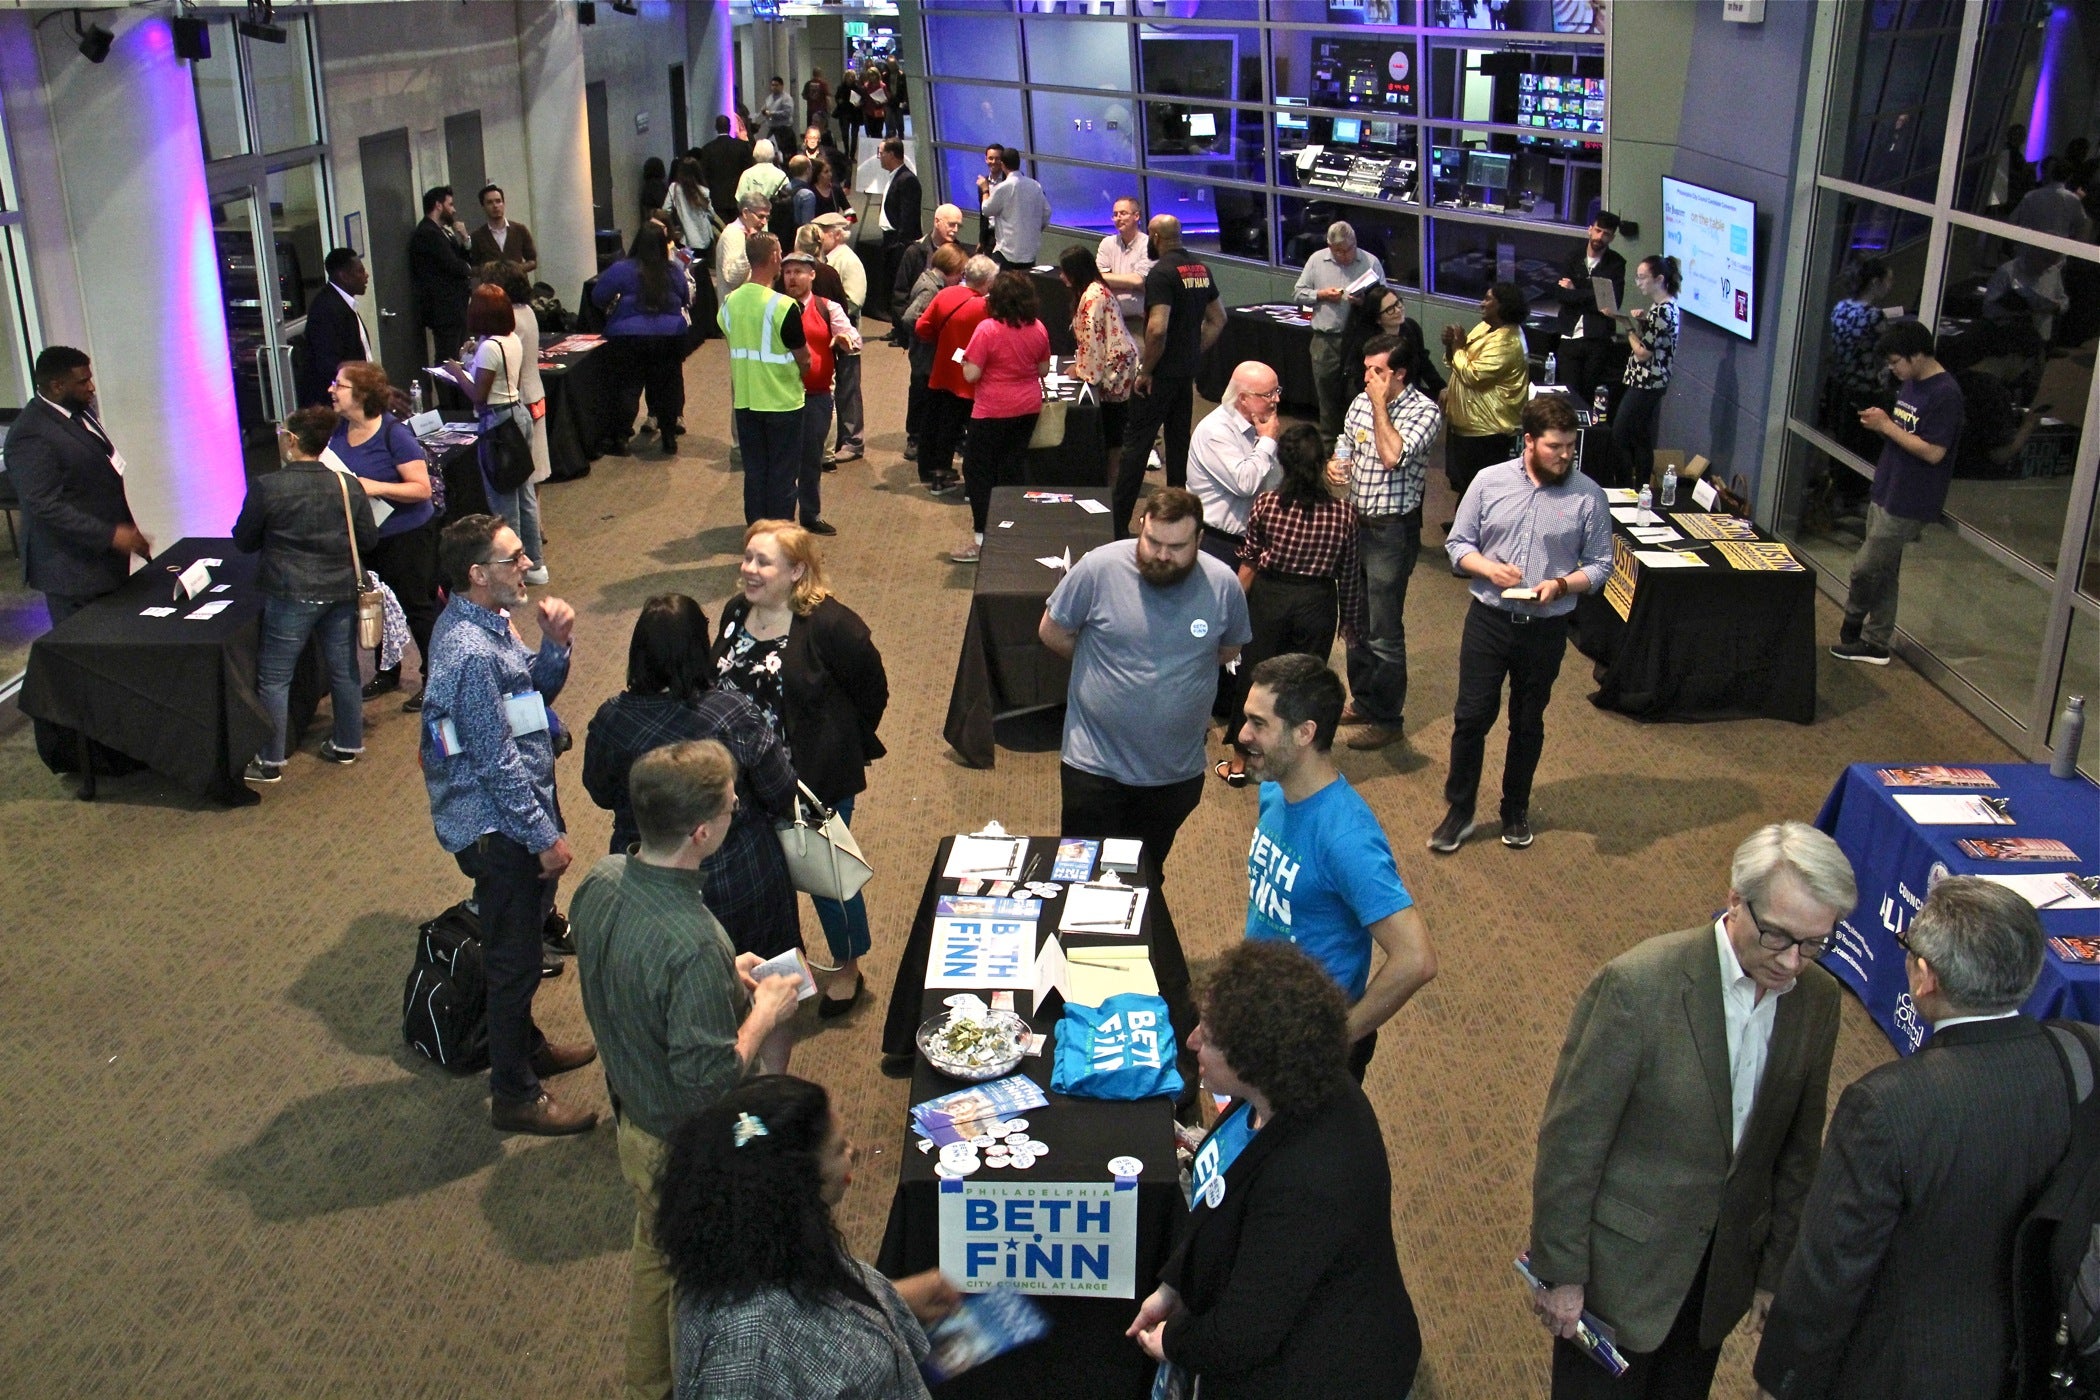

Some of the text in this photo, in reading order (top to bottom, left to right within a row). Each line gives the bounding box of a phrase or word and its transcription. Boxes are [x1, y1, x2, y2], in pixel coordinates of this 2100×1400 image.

[1249, 827, 1300, 893] BETH
[987, 923, 1021, 978] BTH
[966, 1188, 1111, 1197] PHILADELPHIA
[966, 1199, 1111, 1233] BETH
[966, 1280, 1109, 1291] CITY COUNCIL AT LARGE
